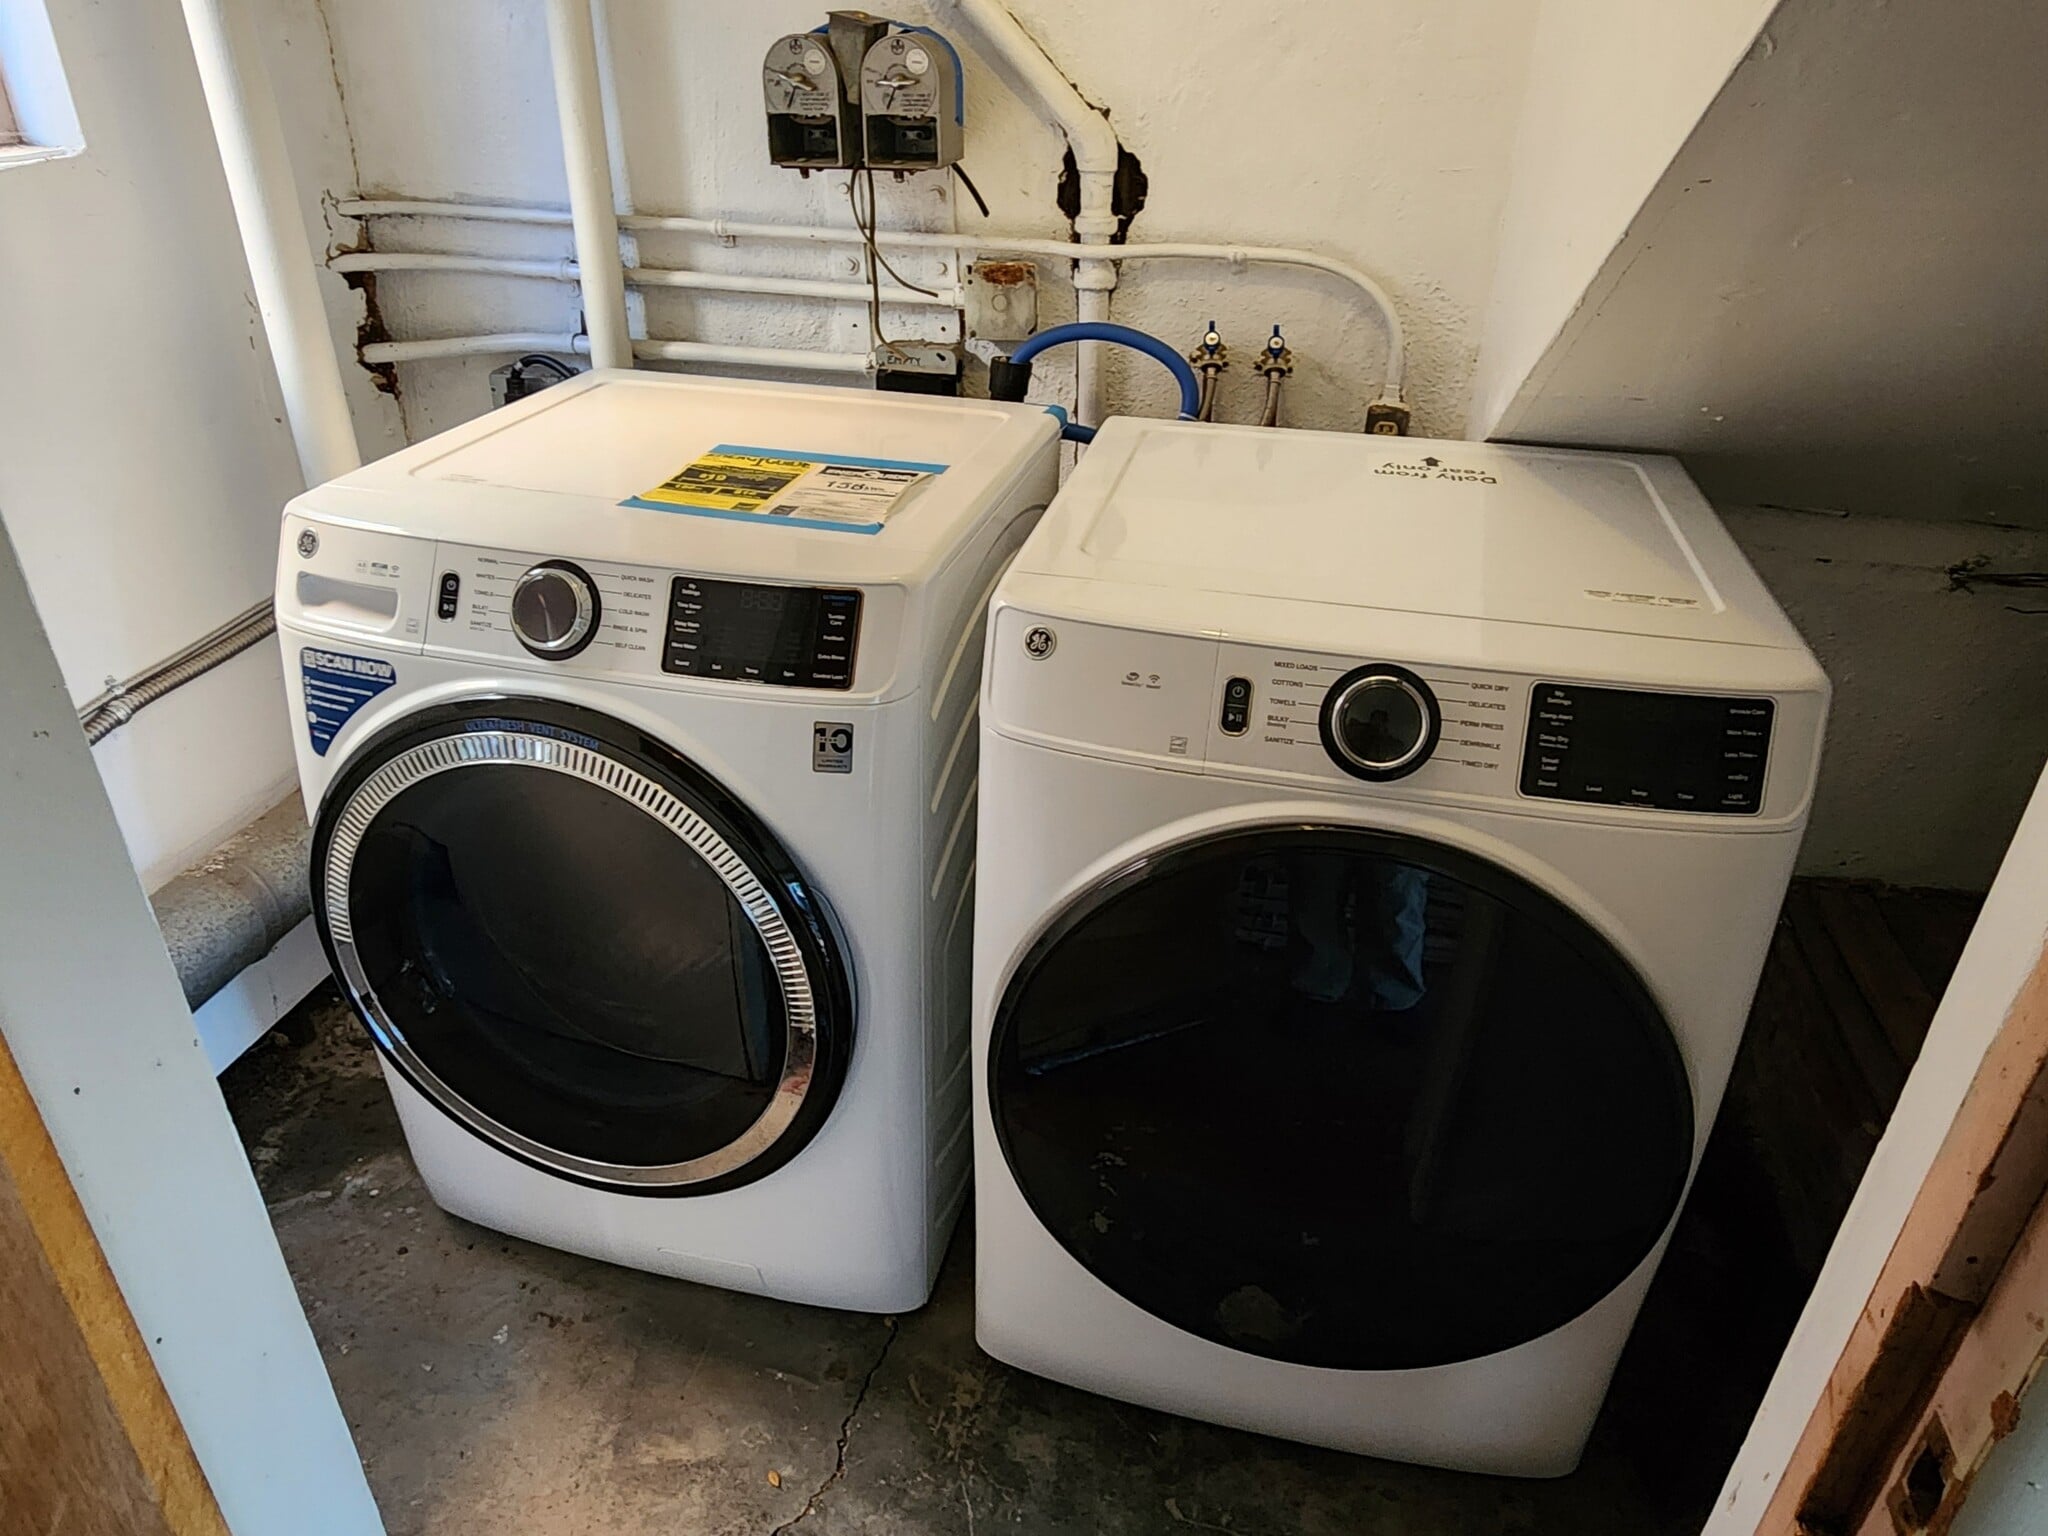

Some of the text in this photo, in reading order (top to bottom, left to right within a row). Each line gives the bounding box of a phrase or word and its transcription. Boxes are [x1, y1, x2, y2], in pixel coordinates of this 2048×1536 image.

[1383, 463, 1431, 471] only
[1374, 469, 1497, 483] Dolly from
[620, 574, 637, 582] QUICK
[623, 591, 652, 600] DELICATES
[628, 643, 646, 651] CLEAN
[315, 652, 353, 671] SCAN
[355, 659, 393, 678] NOW
[1274, 661, 1318, 671] MIXED LOADS
[1271, 679, 1303, 688] COTTONS
[1471, 682, 1510, 692] QUICK DRY
[1269, 698, 1296, 707] TOWELS
[1468, 701, 1506, 711] DELICATES
[1546, 697, 1573, 706] Settings
[1267, 714, 1289, 723] BULKY
[1460, 720, 1504, 731] PERM PRESS
[464, 719, 599, 750] ULTRAFRESH VENT SYSTEM
[814, 728, 852, 754] 10
[1264, 736, 1294, 745] SANITIZE
[1459, 739, 1501, 750] DEWRINKLE
[1461, 759, 1499, 770] TIMED DRY
